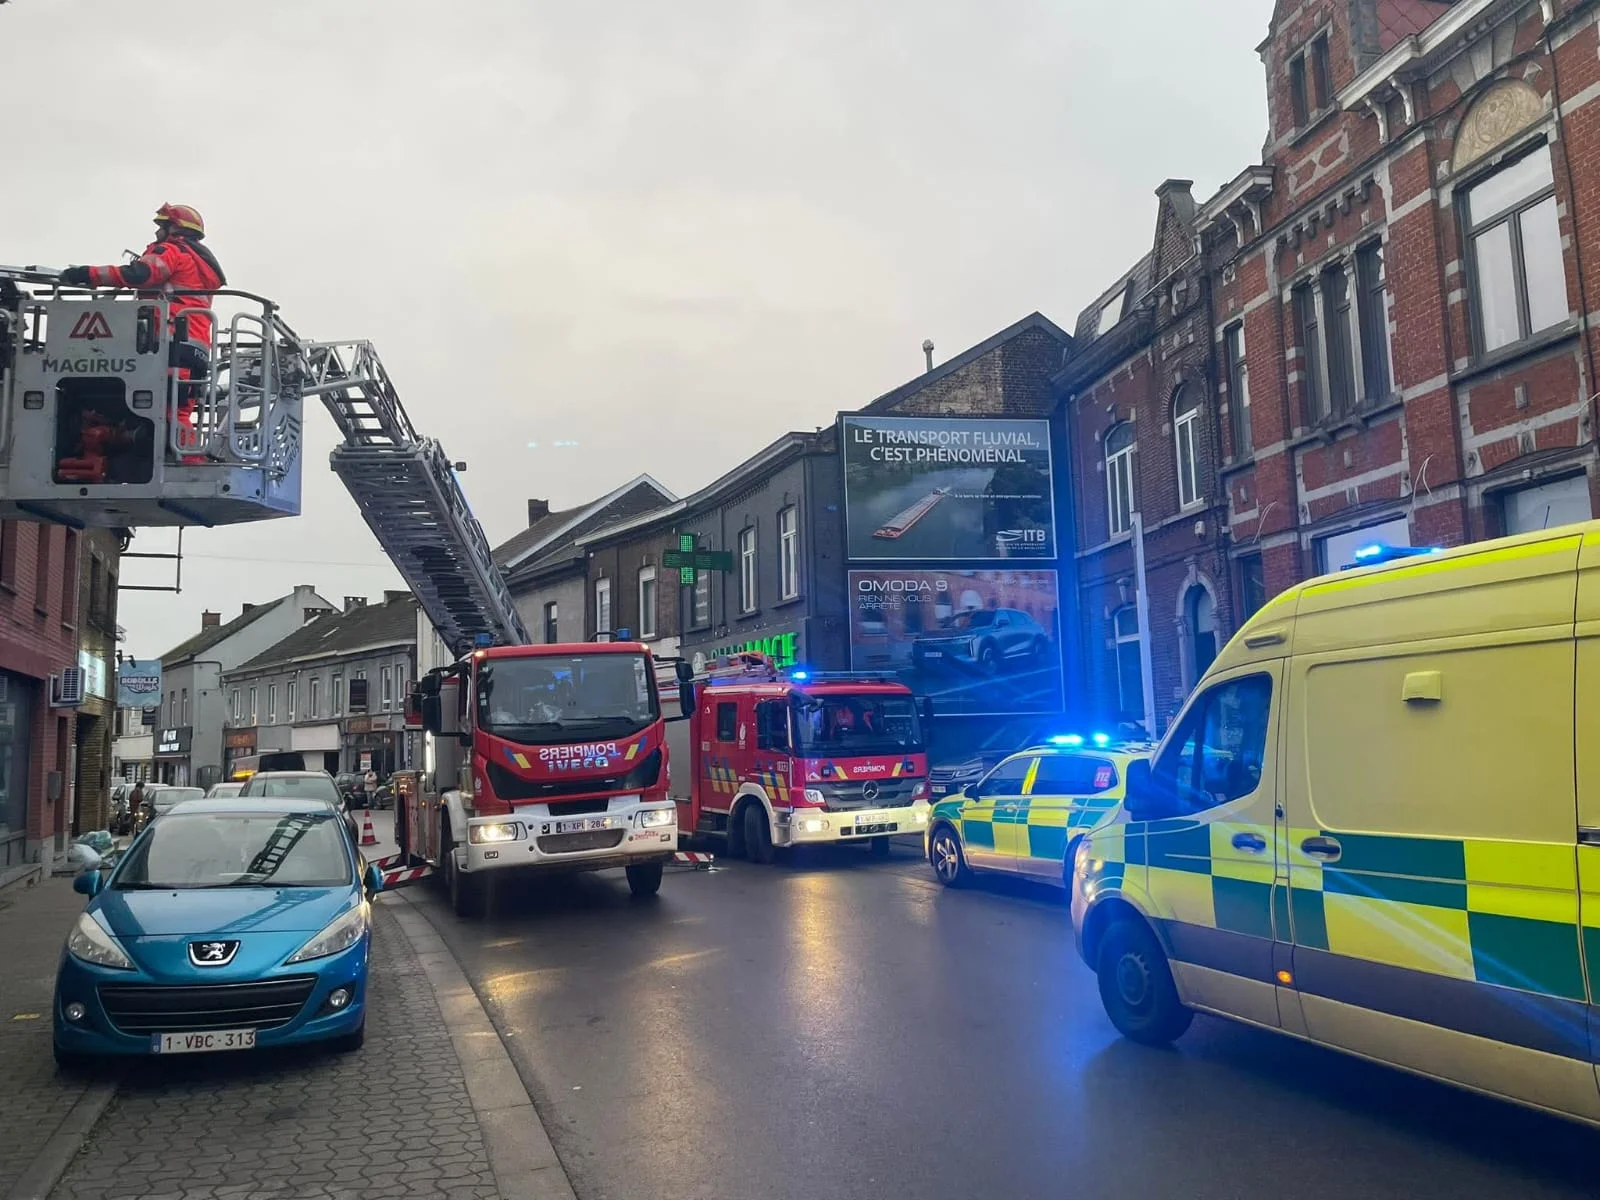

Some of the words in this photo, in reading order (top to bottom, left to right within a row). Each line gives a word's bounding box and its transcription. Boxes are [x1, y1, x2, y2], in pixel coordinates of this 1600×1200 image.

[42, 359, 136, 372] MAGIRUS
[855, 429, 872, 443] LE
[876, 430, 970, 445] TRANSPORT
[973, 431, 1040, 448] FLUVIAL,
[870, 446, 912, 462] C'EST
[916, 445, 1026, 463] PHÉNOMÉNAL
[1024, 530, 1046, 542] ITB
[858, 580, 931, 592] OMODA
[936, 580, 948, 592] 9
[548, 757, 608, 772] IVECO
[1096, 771, 1109, 782] 112
